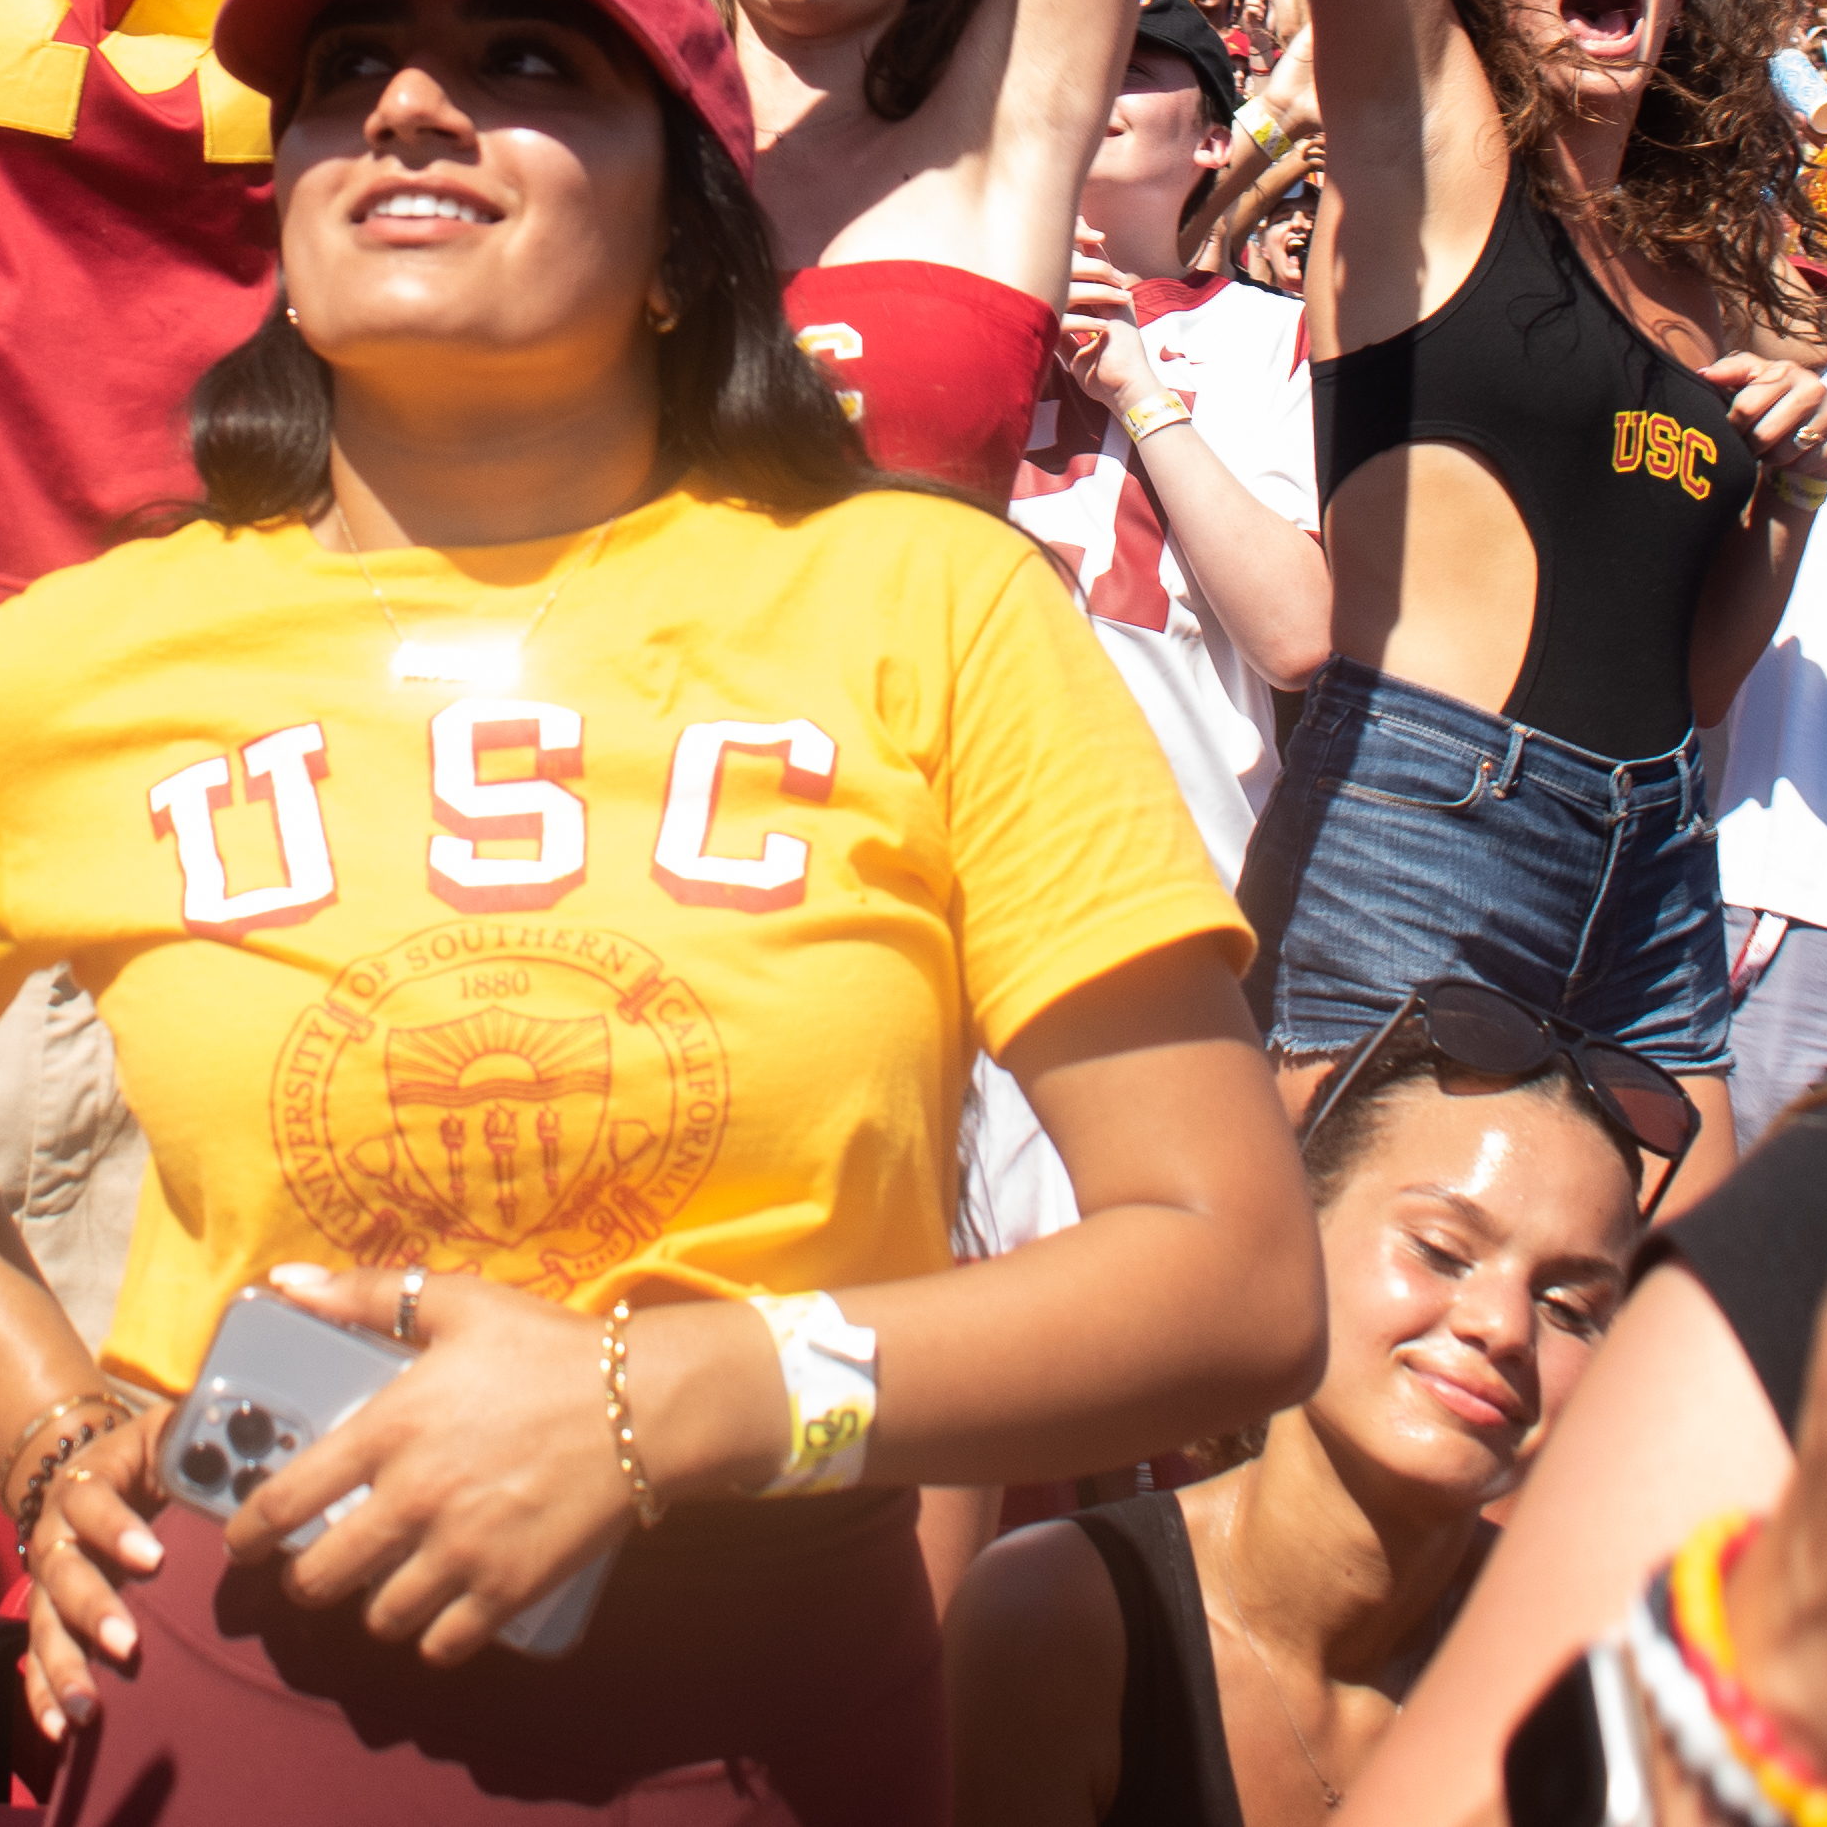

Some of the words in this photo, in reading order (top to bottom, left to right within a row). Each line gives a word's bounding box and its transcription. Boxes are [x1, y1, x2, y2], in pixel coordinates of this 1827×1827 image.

[1611, 410, 1717, 500] USC
[148, 698, 837, 942] USC
[357, 956, 391, 1000] OF
[405, 925, 636, 975] SOUTHERN
[459, 970, 531, 1000] 1880
[283, 1017, 361, 1241] UNIVERSITY
[649, 997, 718, 1202] CALIFORNIA
